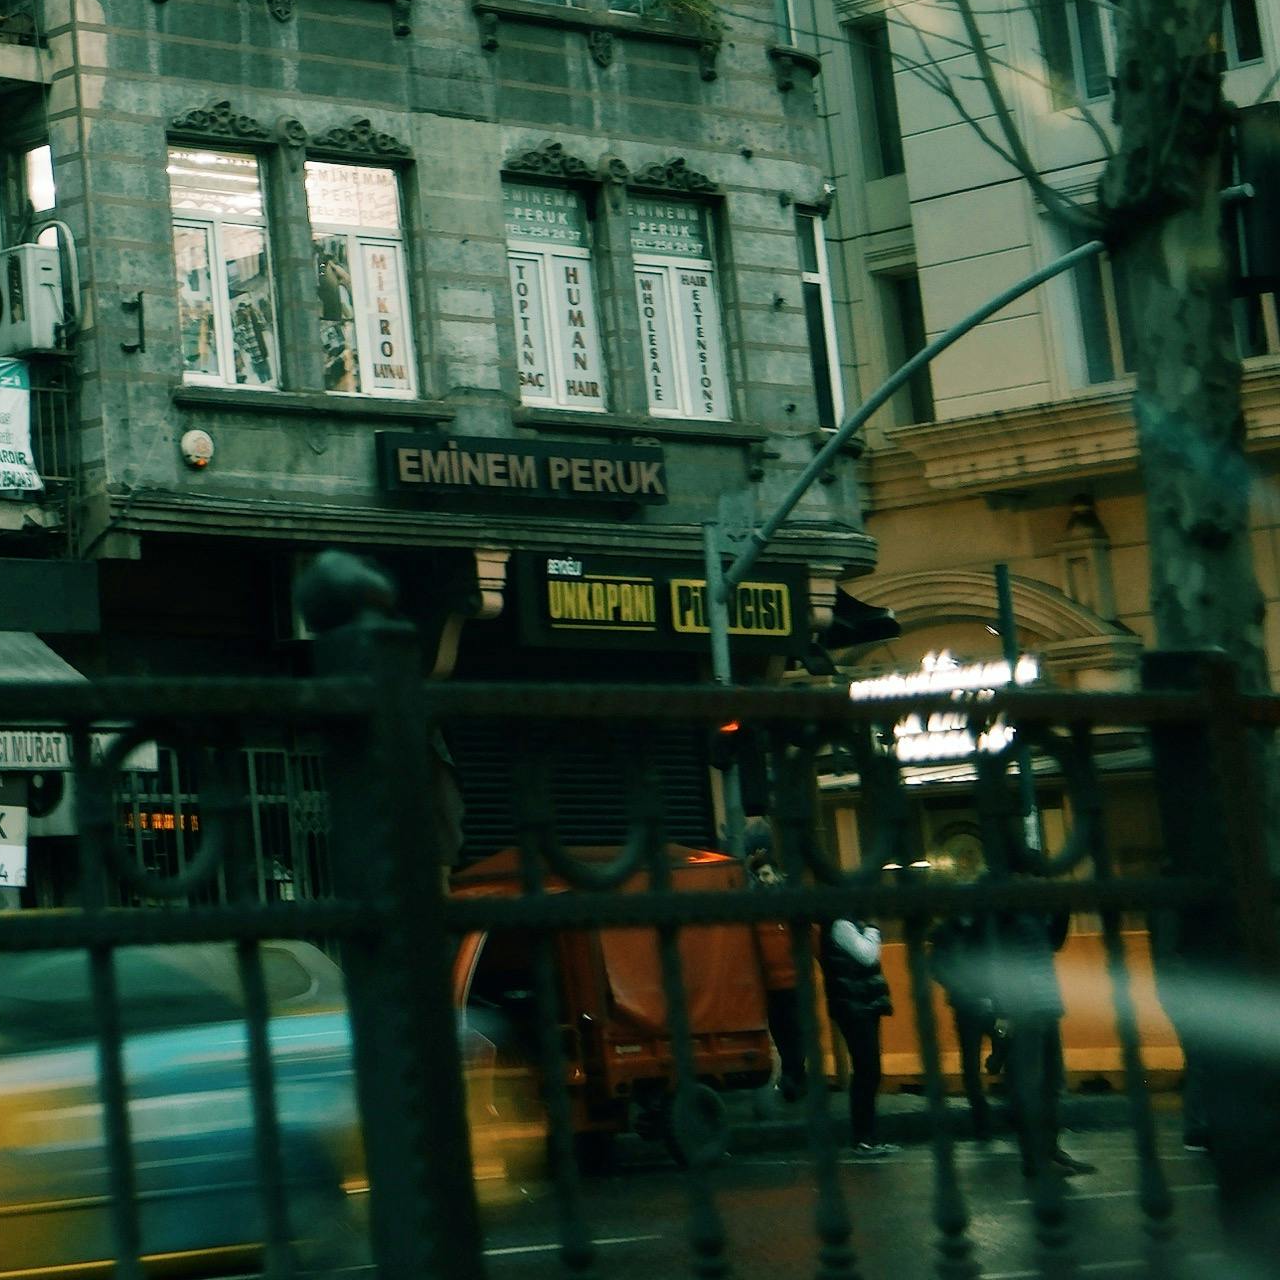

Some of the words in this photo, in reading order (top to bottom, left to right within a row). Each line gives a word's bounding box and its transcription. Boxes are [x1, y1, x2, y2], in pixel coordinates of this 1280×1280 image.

[514, 207, 568, 226] PERUK
[639, 221, 690, 238] PERUK
[681, 274, 708, 287] HAIR
[516, 265, 535, 366] TOPTAN
[565, 266, 588, 371] HUMAN
[640, 278, 664, 401] WHOLESALE
[691, 289, 714, 414] EXTENSIONS
[566, 379, 600, 398] HAIR
[397, 440, 538, 489] EMİNEM
[548, 456, 665, 495] PERUK
[548, 580, 657, 623] UNKAPANI
[13, 734, 62, 764] MURAT
